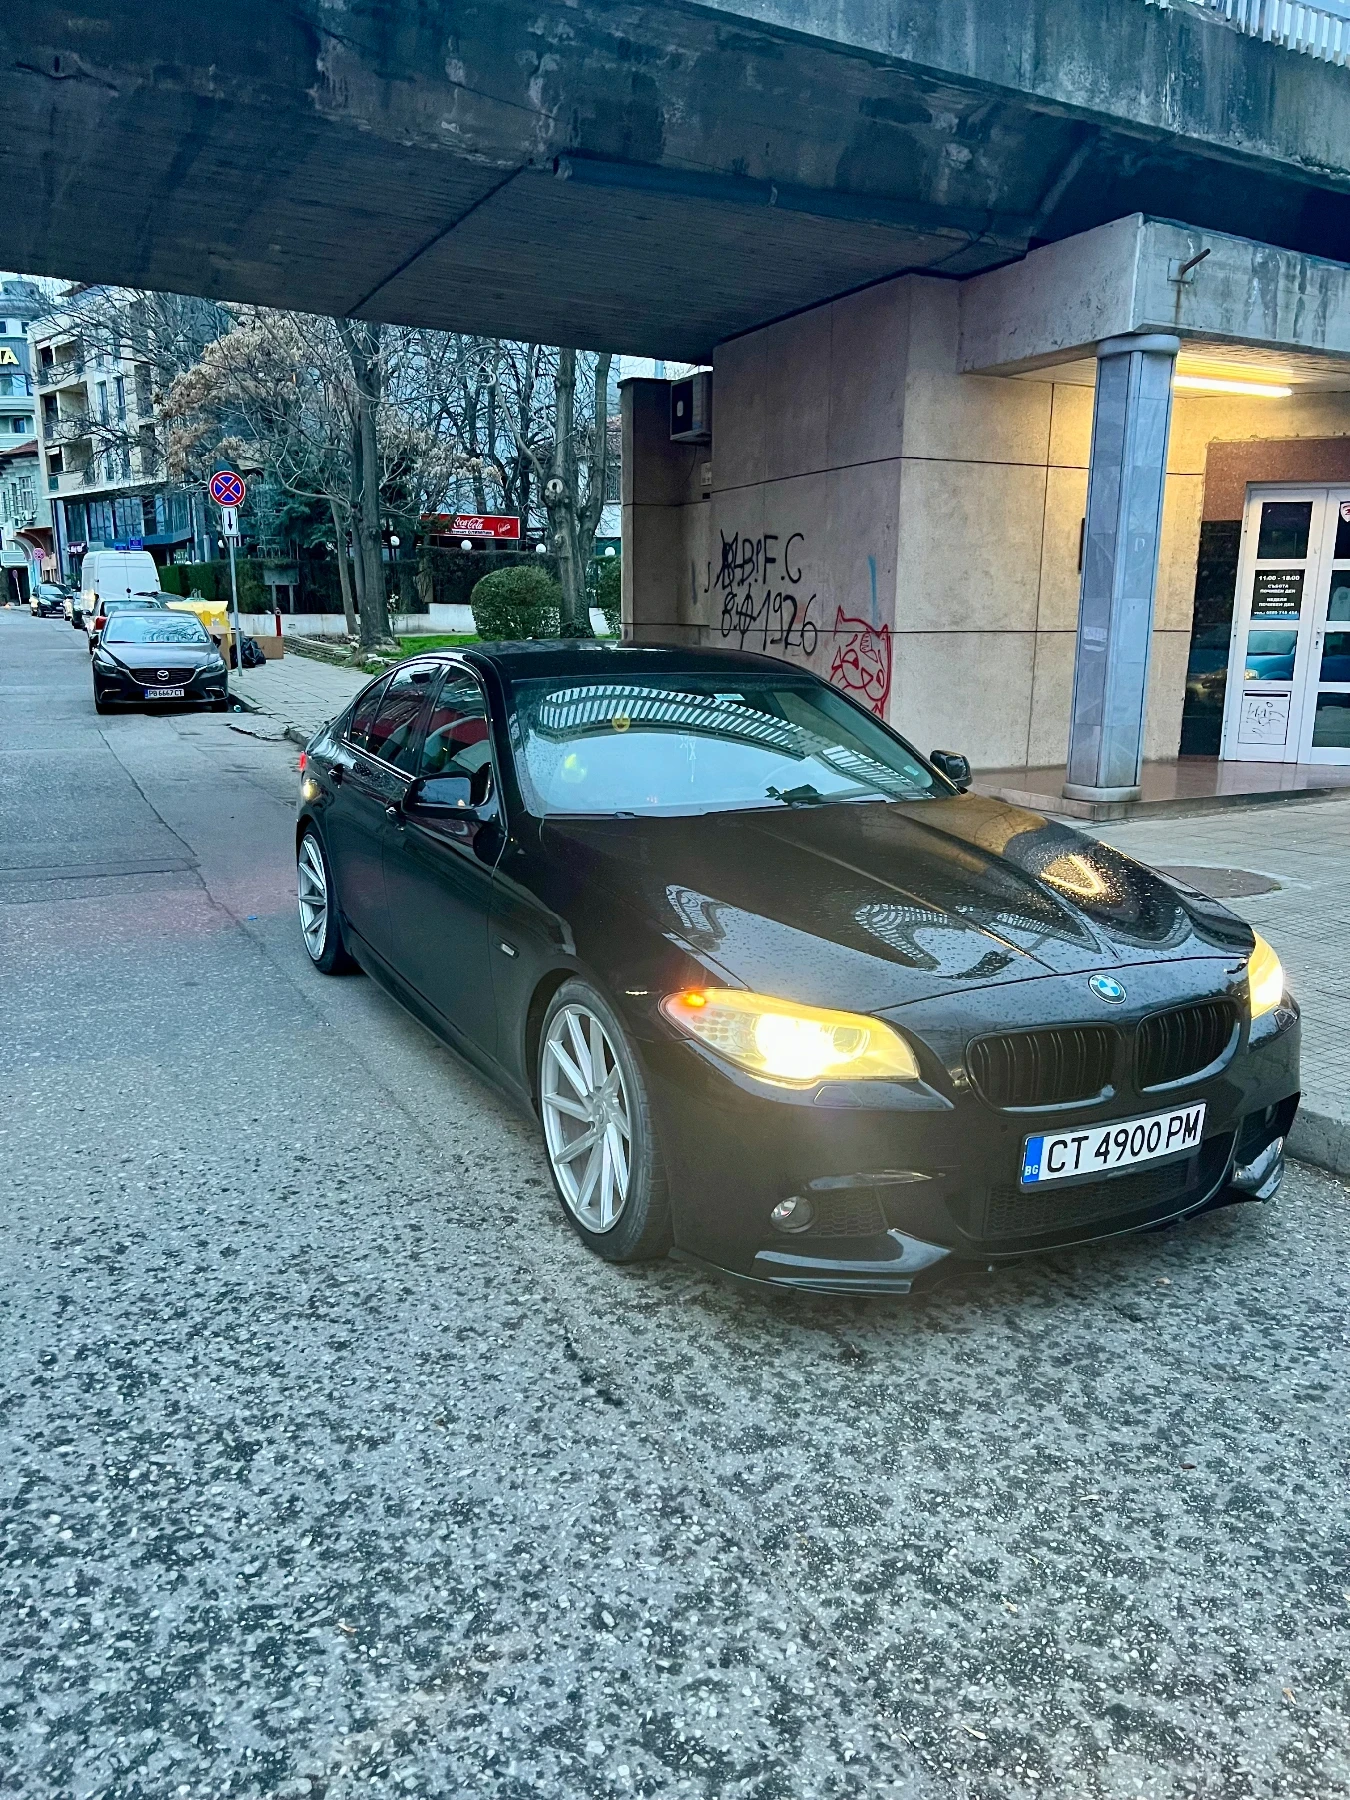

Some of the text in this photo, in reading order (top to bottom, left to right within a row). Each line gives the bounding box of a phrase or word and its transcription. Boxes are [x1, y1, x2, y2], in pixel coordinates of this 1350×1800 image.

[1046, 1109, 1201, 1173] CT 4900 PM
[1024, 1164, 1039, 1176] BG
